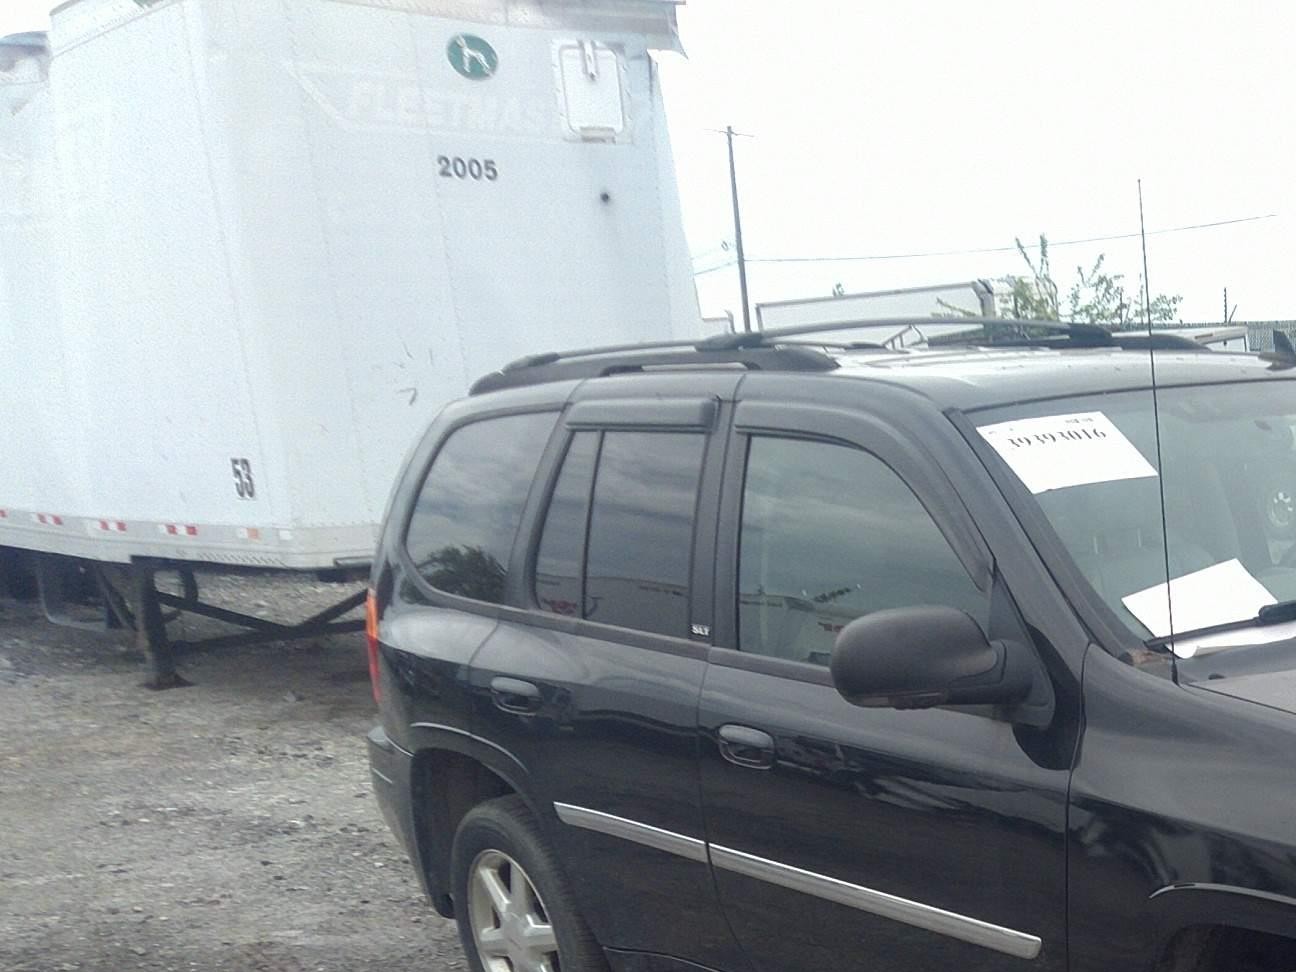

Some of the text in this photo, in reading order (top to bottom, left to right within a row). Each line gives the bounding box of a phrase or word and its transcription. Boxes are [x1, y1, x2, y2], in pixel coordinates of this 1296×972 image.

[437, 154, 498, 181] 2005
[1007, 428, 1107, 448] 39393016
[230, 458, 255, 498] 53
